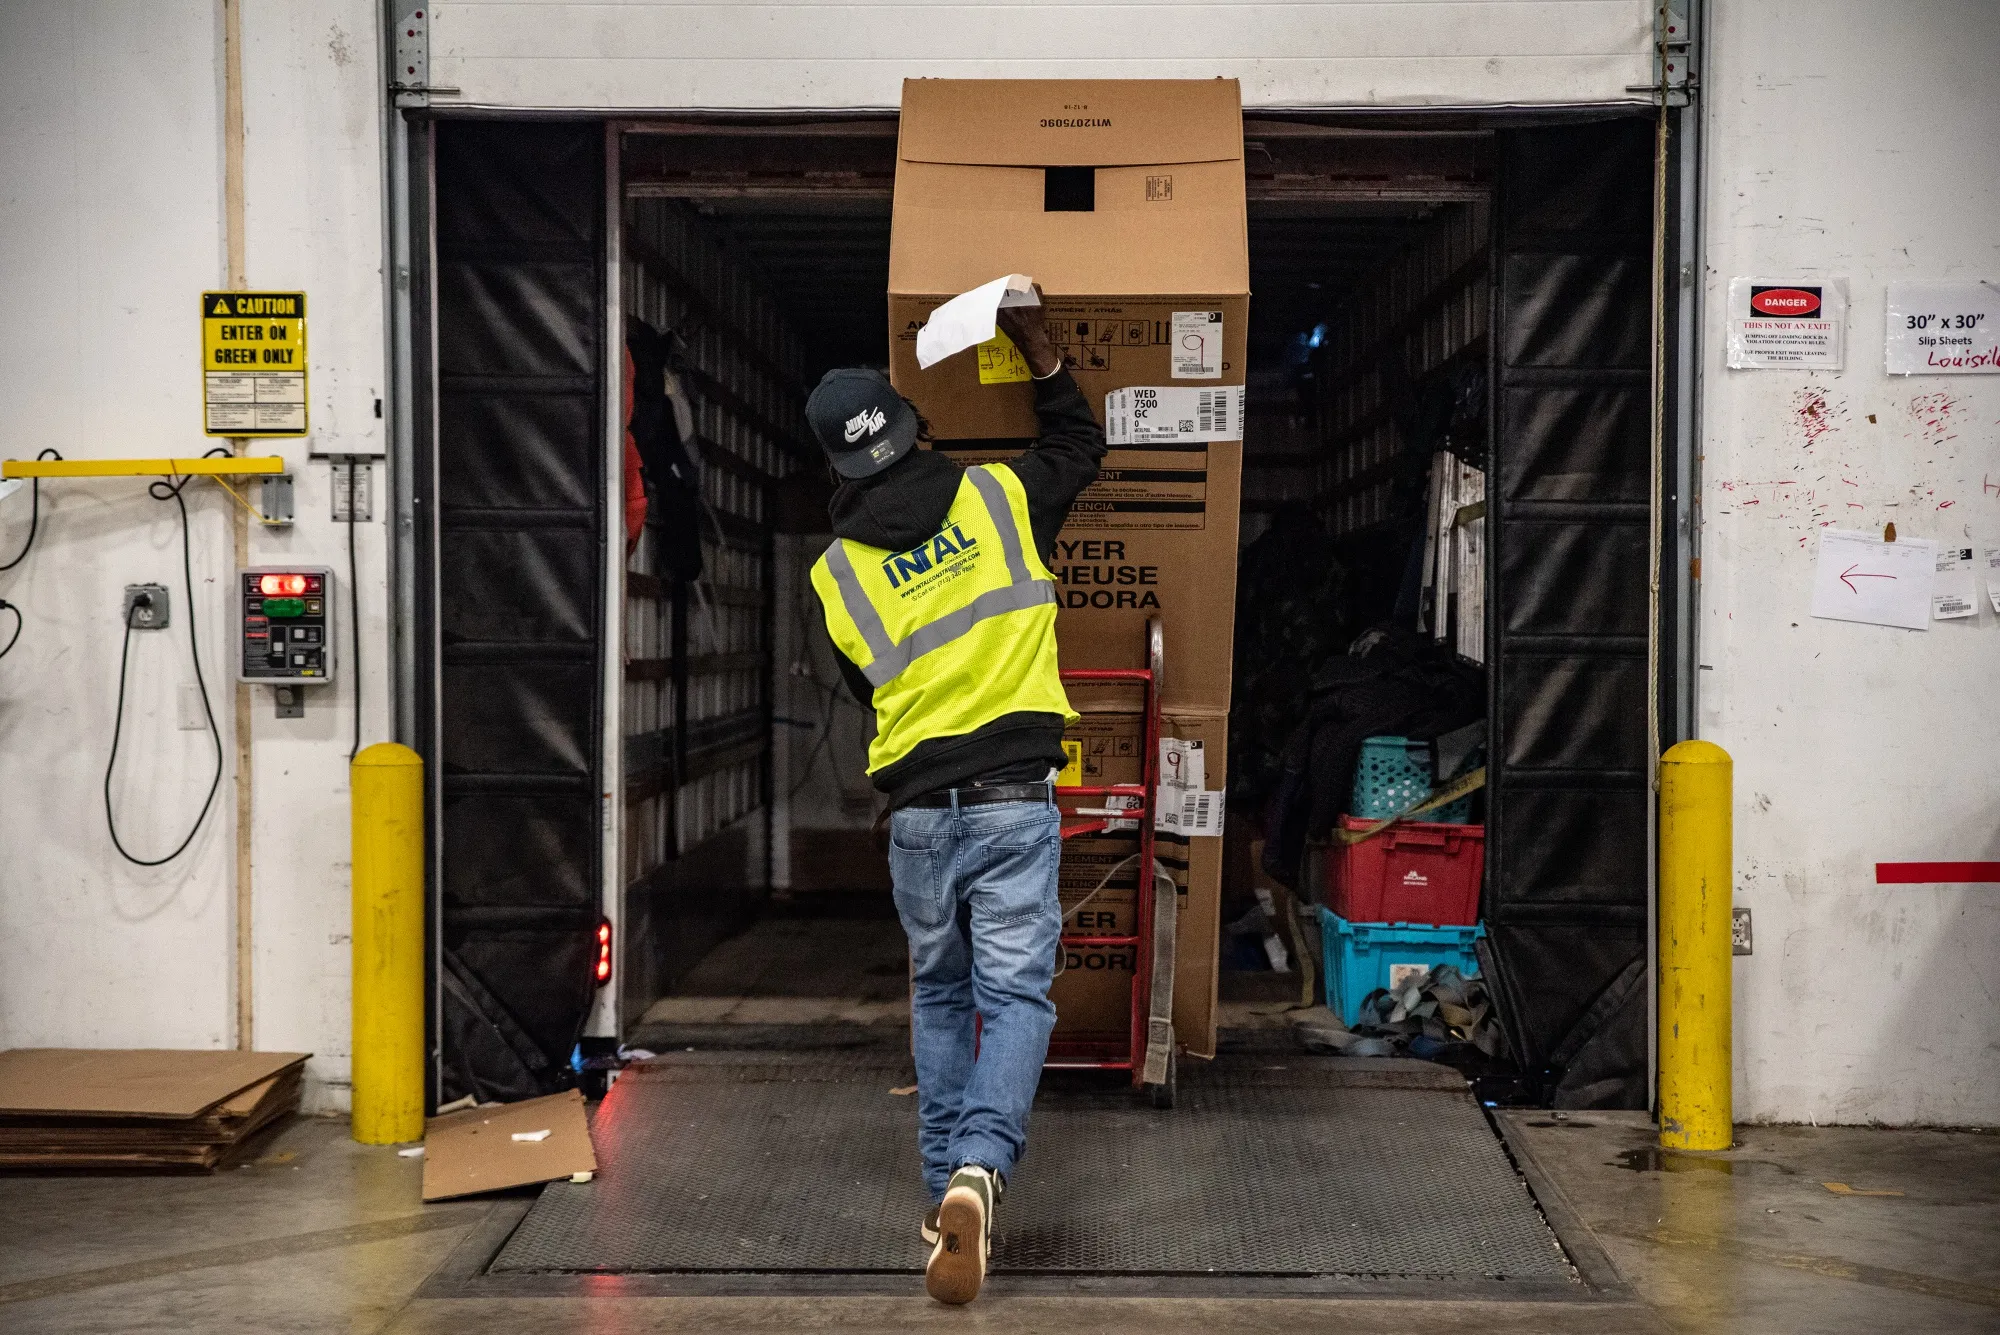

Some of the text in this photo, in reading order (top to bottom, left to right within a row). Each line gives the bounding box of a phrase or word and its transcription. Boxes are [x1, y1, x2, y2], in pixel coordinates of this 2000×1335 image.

[1040, 119, 1112, 128] W11207509C
[236, 298, 296, 314] CAUTION
[1764, 298, 1807, 307] DANGER
[1941, 318, 1950, 329] x
[221, 325, 287, 340] ENTER ON
[1918, 336, 1972, 347] Slip Sheets
[215, 349, 294, 364] GREEN ONLY
[1134, 390, 1156, 398] WED
[1134, 400, 1158, 408] 7500
[1135, 409, 1148, 418] GC
[845, 409, 869, 434] NIKE
[869, 411, 887, 436] AIR
[883, 525, 977, 589] INTAL
